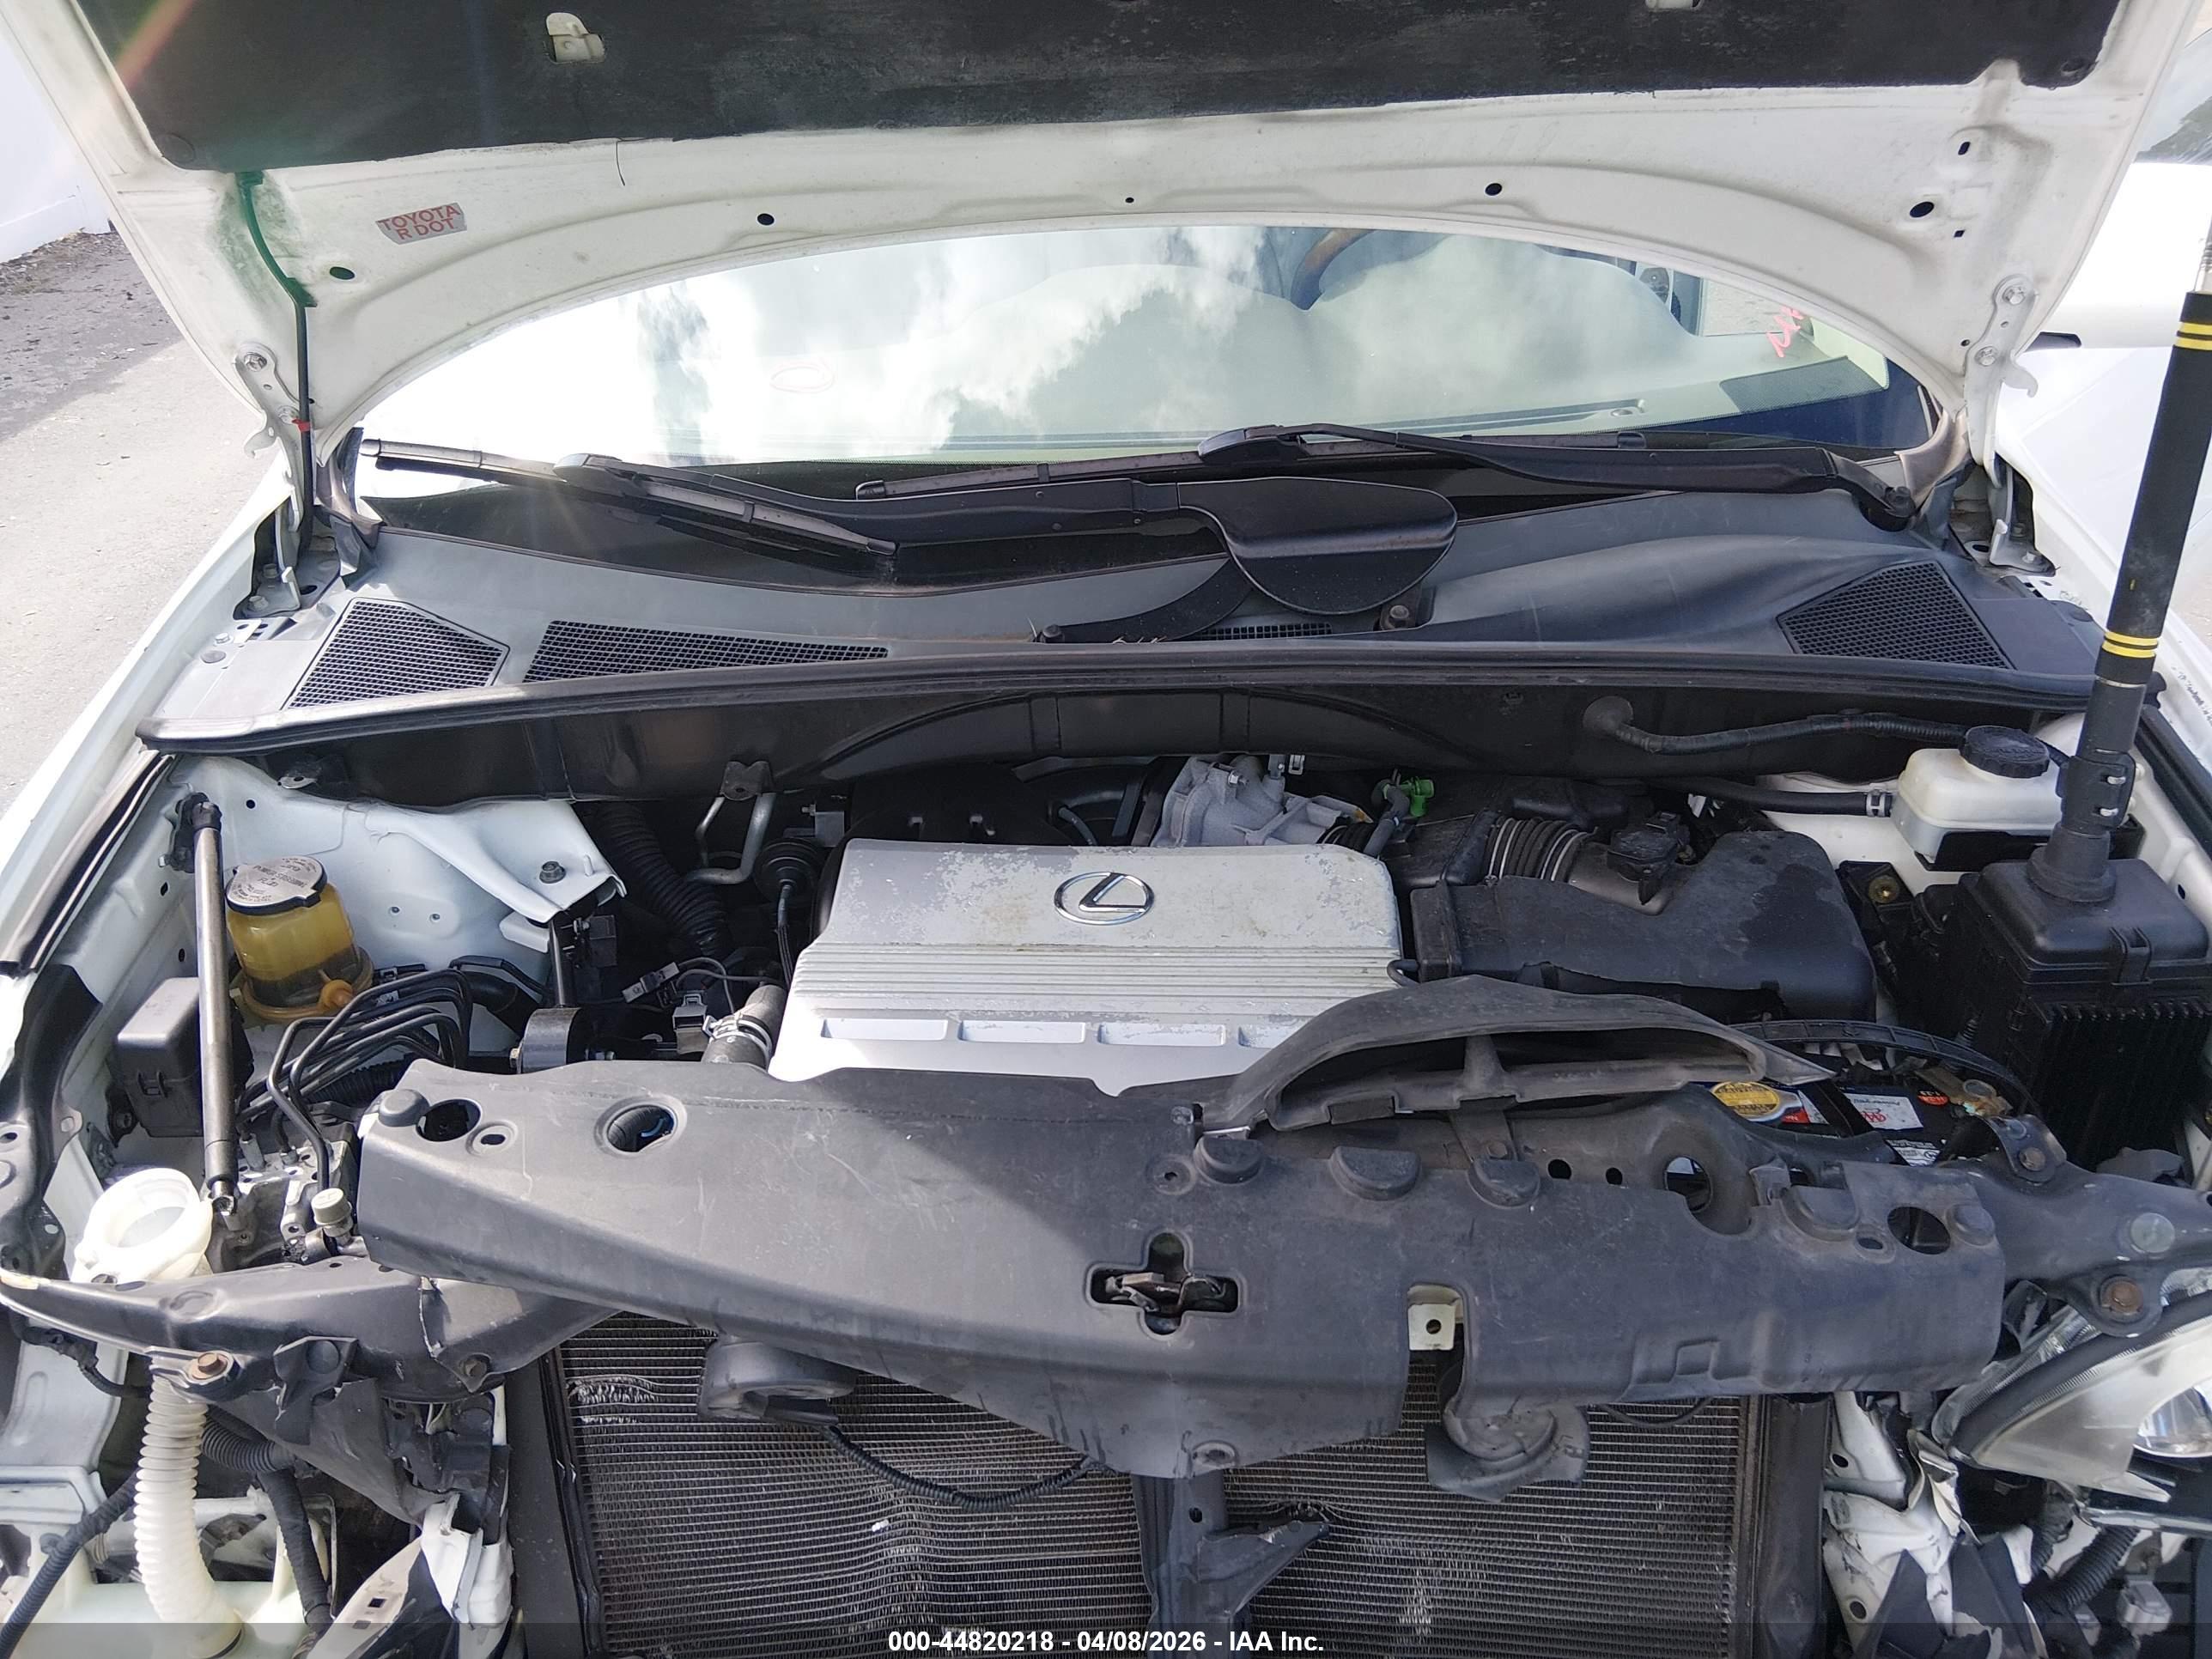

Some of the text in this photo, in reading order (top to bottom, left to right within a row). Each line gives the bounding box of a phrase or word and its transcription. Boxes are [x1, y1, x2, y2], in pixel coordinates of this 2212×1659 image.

[377, 205, 460, 231] TOYOTA
[397, 217, 454, 240] R DOT
